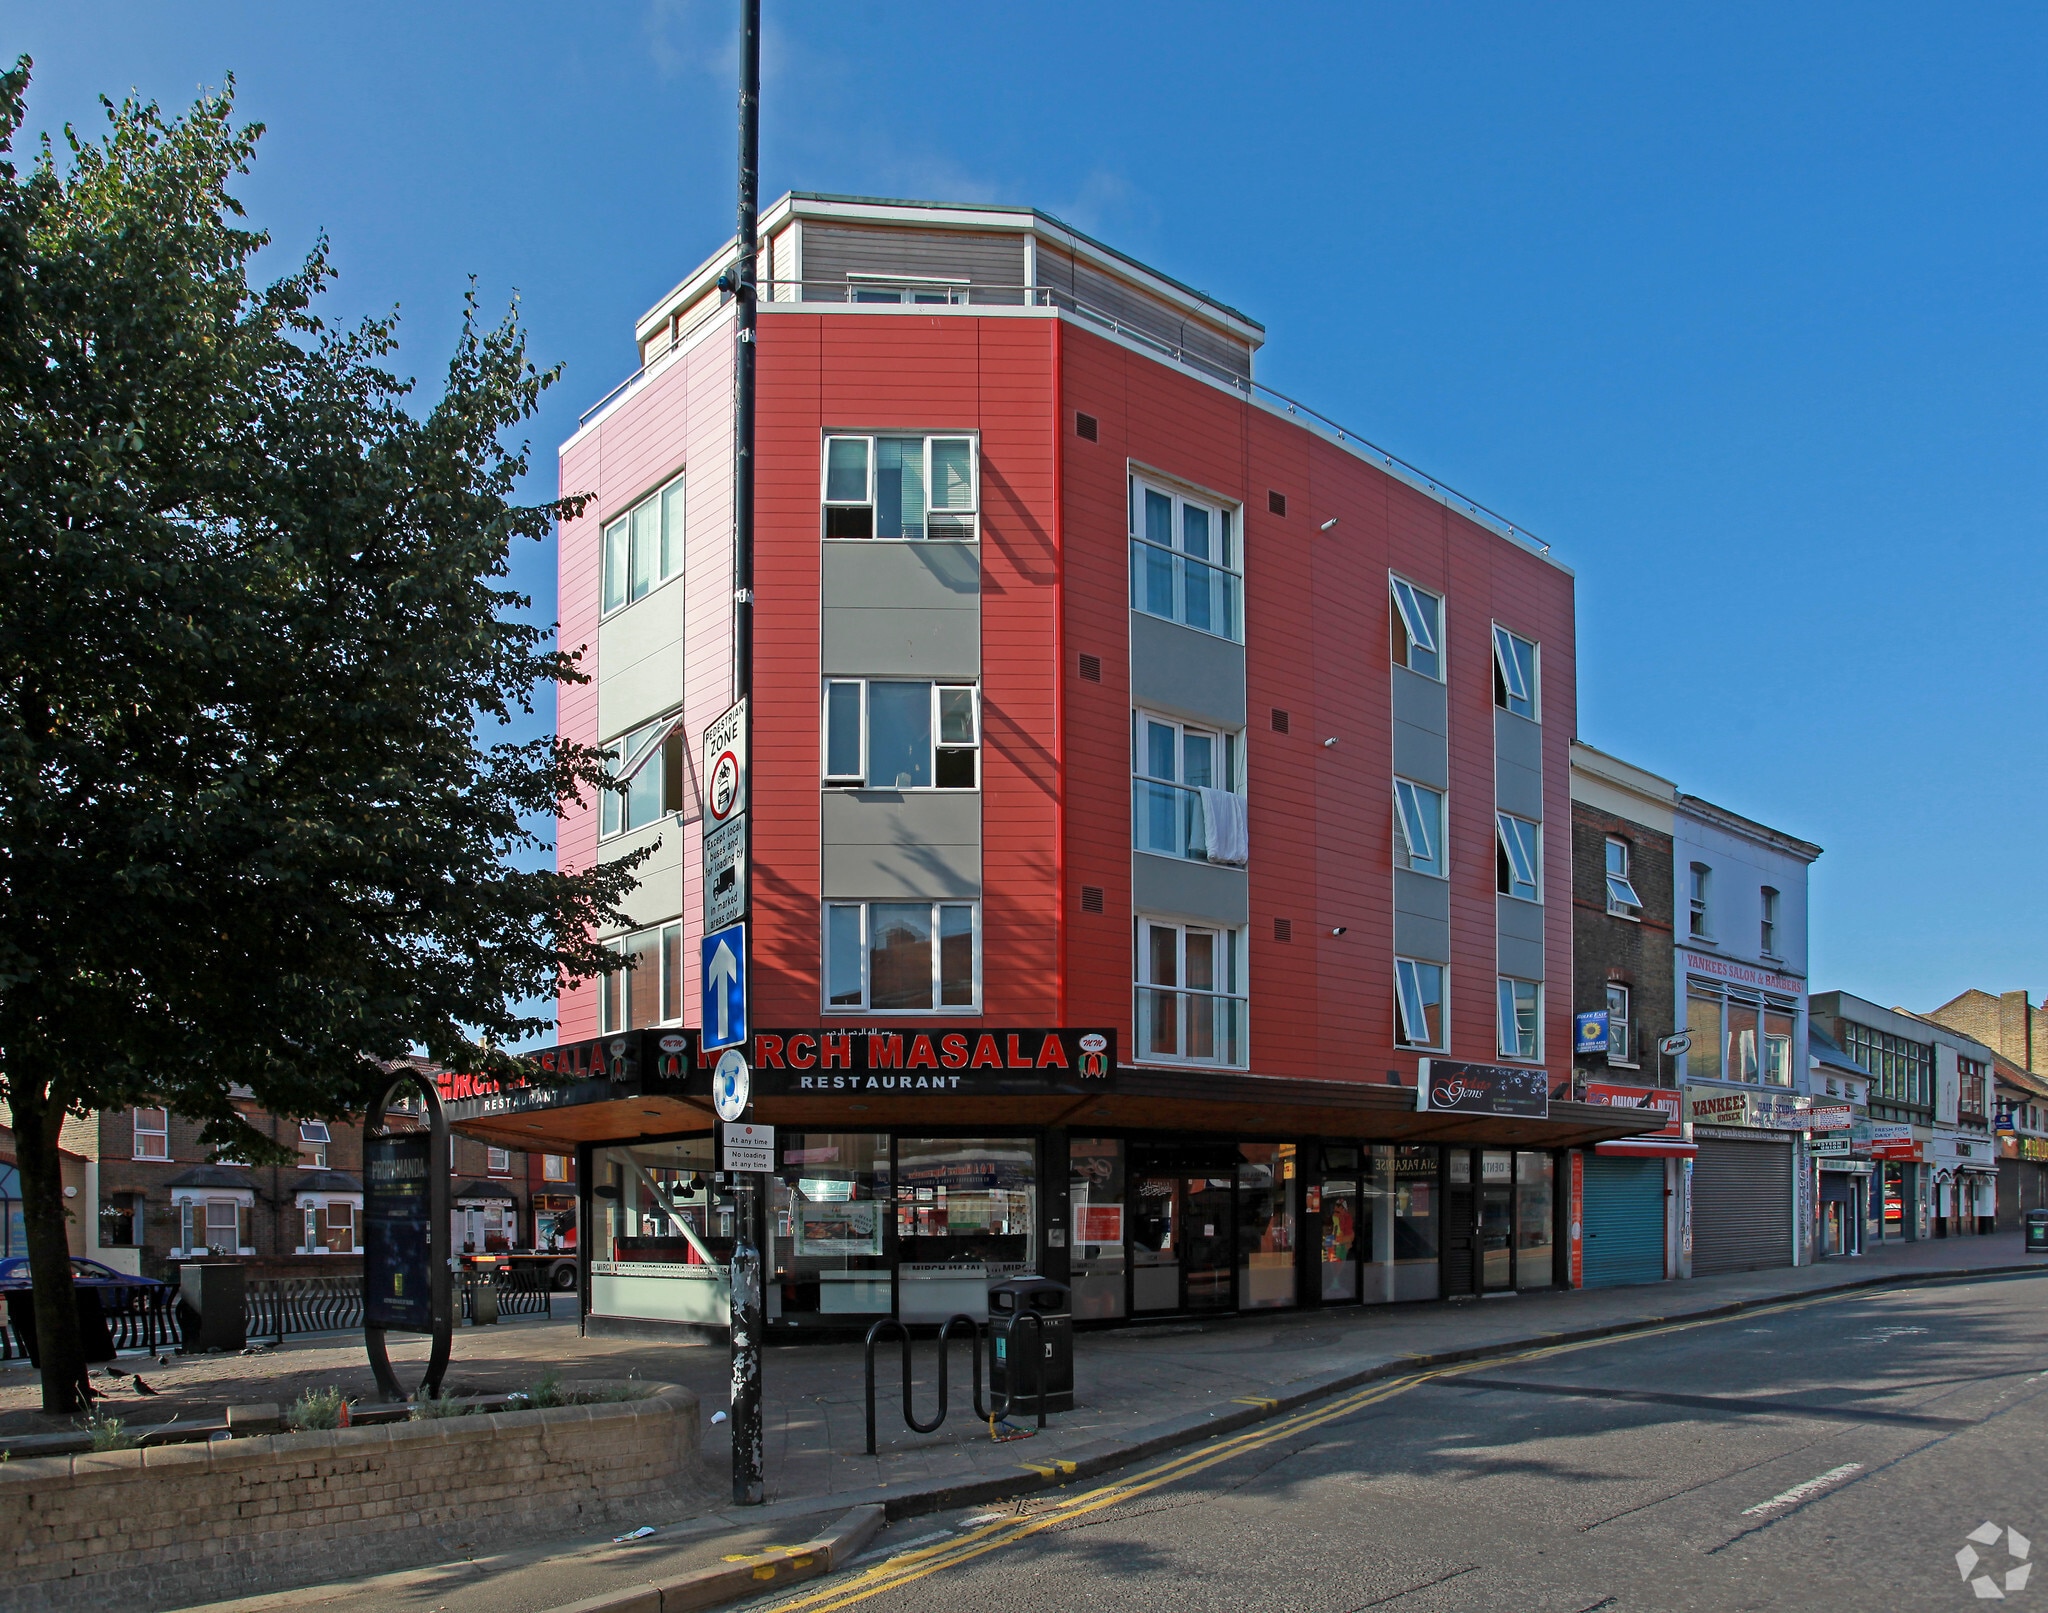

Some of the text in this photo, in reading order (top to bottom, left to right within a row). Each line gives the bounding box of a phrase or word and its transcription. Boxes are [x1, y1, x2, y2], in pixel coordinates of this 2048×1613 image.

[706, 703, 744, 744] PEDESTRIAN
[711, 721, 738, 758] ZONE
[707, 822, 742, 851] Except local
[710, 835, 739, 862] buses and
[705, 847, 744, 878] for loading by
[710, 892, 738, 916] in marked
[710, 907, 739, 929] areas only
[1687, 953, 1801, 993] YANKEES SALON & BARBERS
[661, 1038, 685, 1049] MM
[868, 1033, 1069, 1069] MASALA
[1083, 1038, 1104, 1048] MM
[801, 1076, 961, 1089] RESTAURANT
[484, 1090, 559, 1112] RESTAURANT
[1432, 1080, 1484, 1108] Gems
[1692, 1094, 1746, 1116] YANKEES
[1717, 1112, 1741, 1123] UNISEX
[1693, 1127, 1790, 1141] www.yankeessalon.com
[743, 1151, 766, 1160] loading
[753, 1161, 767, 1169] time
[372, 1158, 425, 1180] PROPAMANDA
